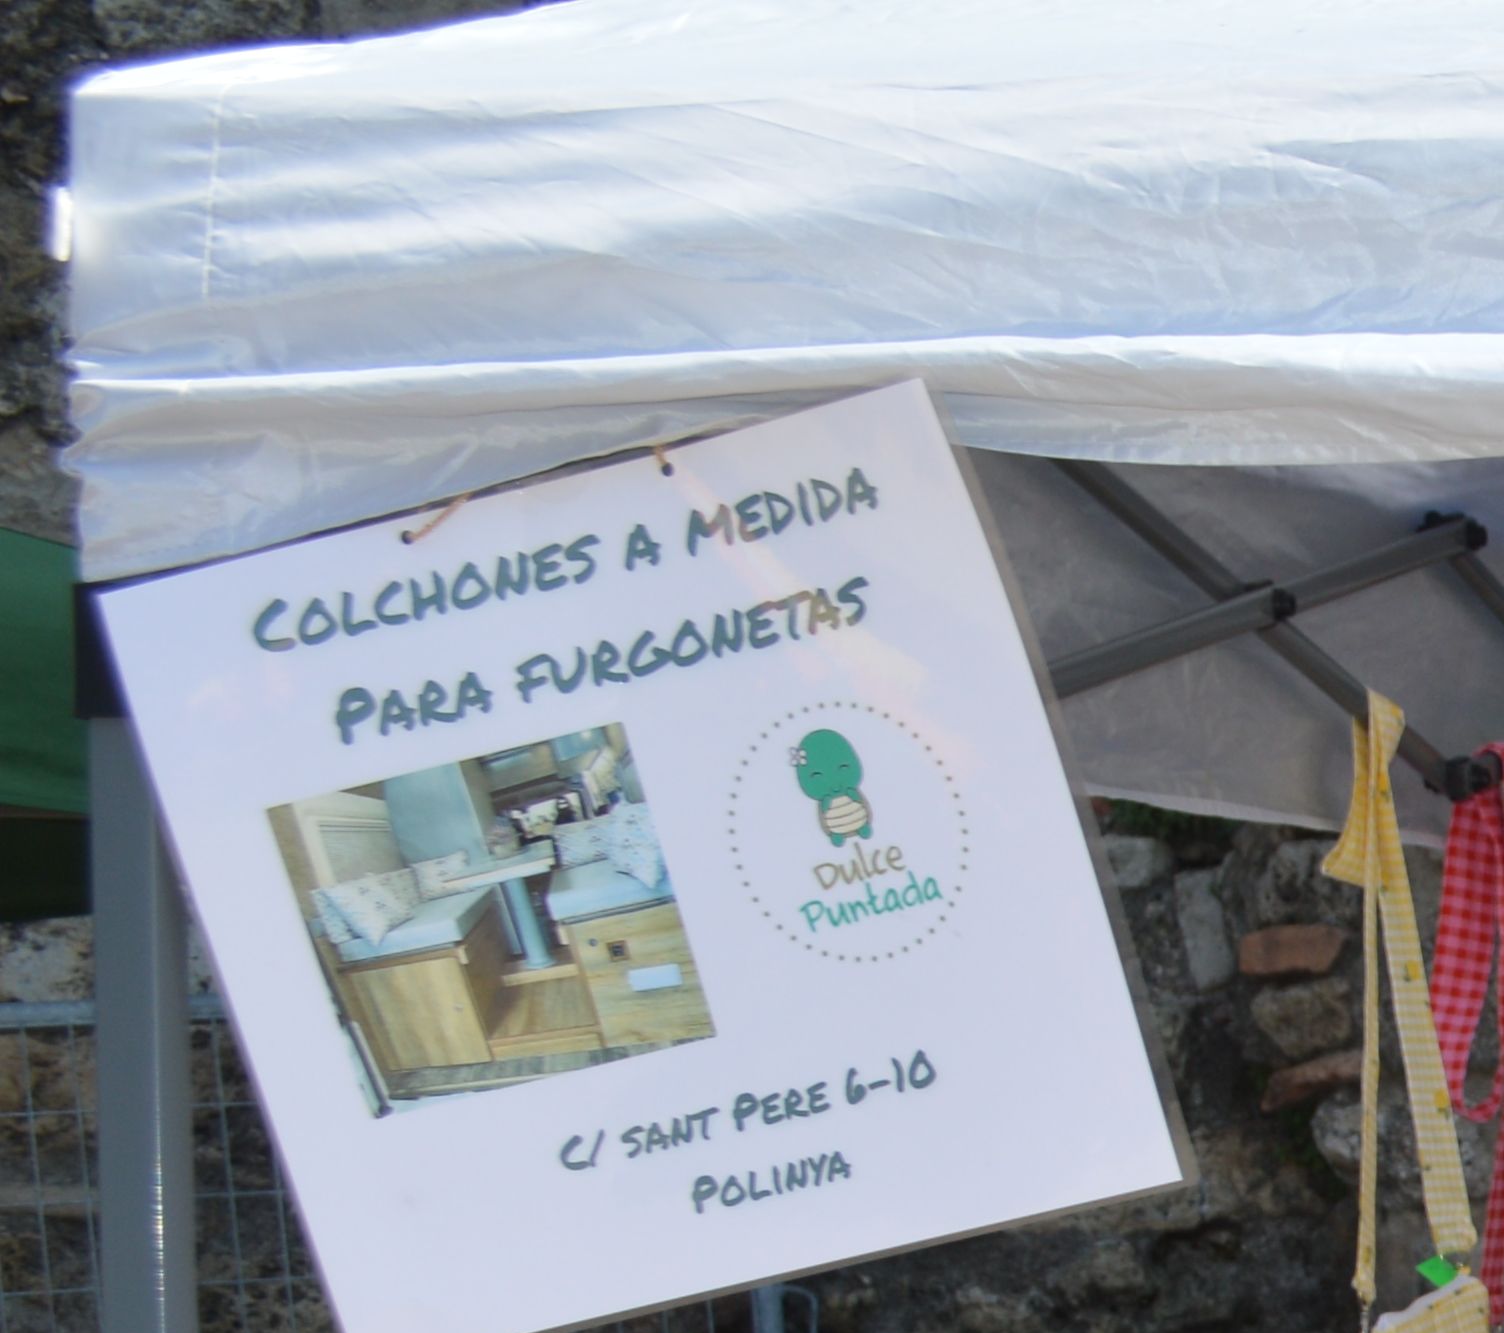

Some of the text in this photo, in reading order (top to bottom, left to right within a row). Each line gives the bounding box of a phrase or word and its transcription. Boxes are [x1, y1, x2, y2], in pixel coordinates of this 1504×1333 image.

[254, 466, 880, 652] COLCHONES A MEDIDA
[335, 575, 871, 745] PARA FURGONETAS
[799, 871, 944, 933] Puntada
[813, 842, 906, 891] Dulce
[559, 1050, 937, 1171] C/ SANT PERE 6-10
[691, 1151, 852, 1214] POLINYA
